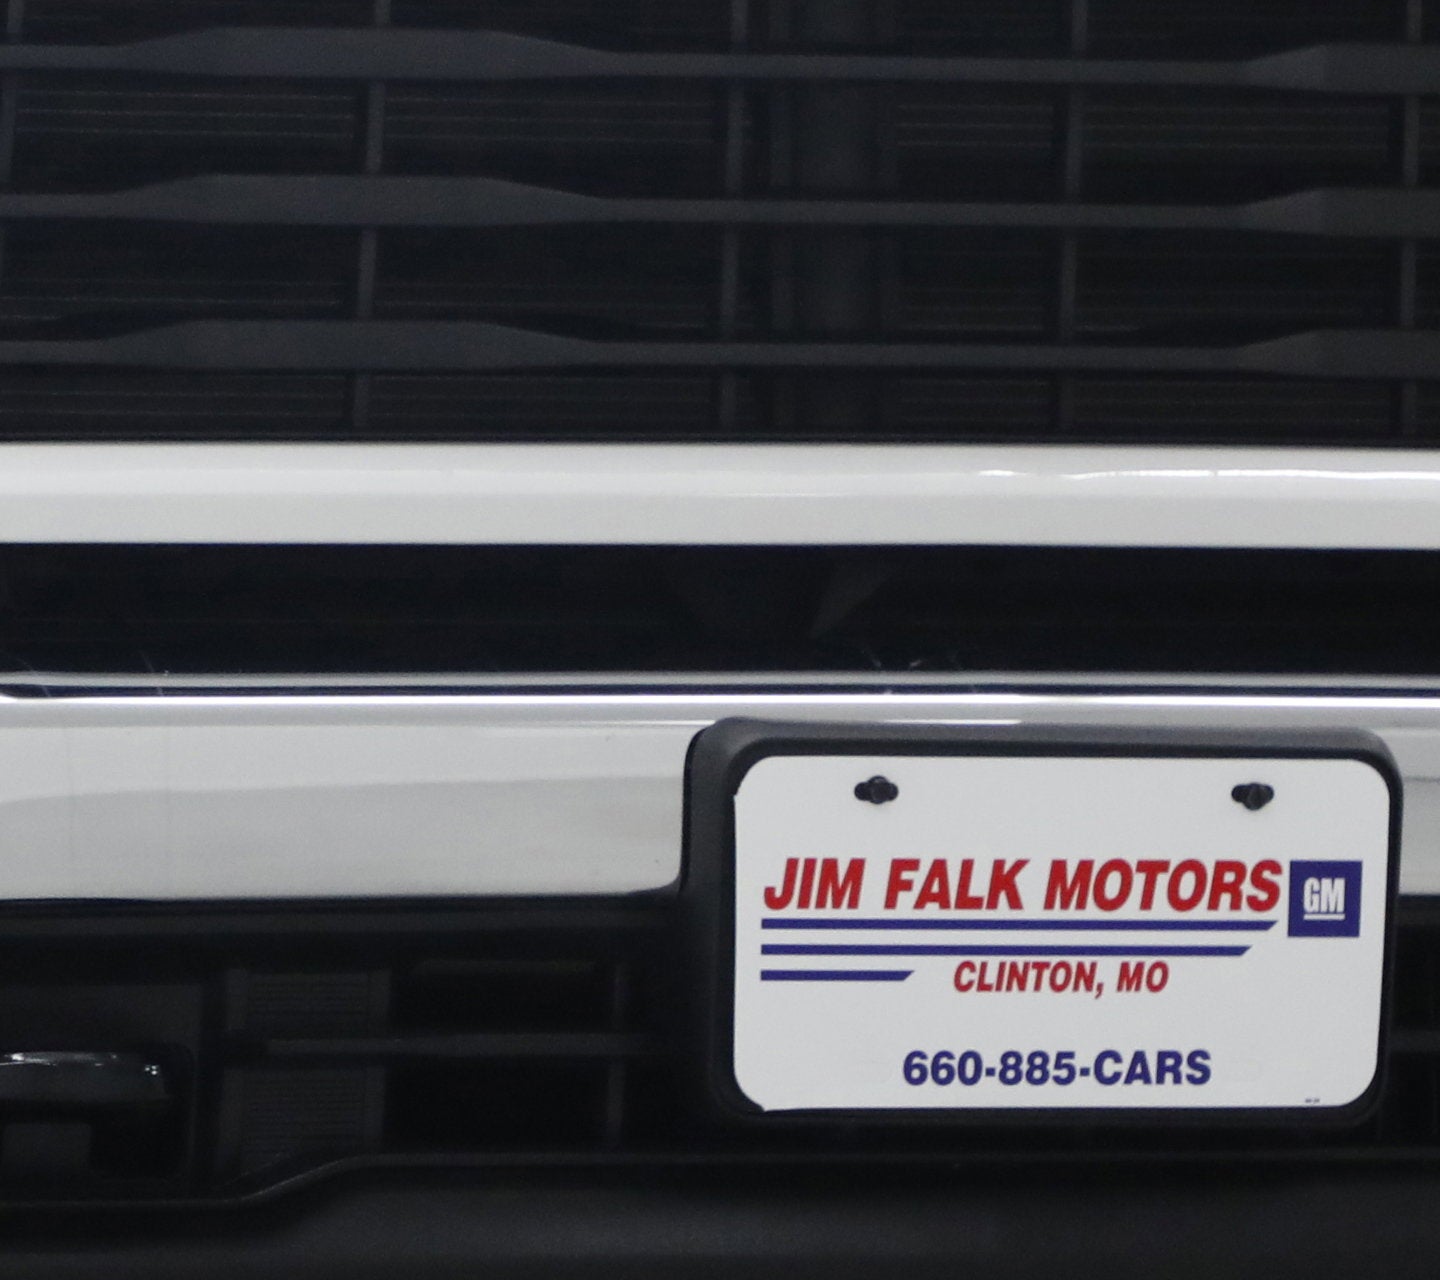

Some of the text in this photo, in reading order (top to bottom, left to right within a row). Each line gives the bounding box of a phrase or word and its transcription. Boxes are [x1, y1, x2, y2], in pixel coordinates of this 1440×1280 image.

[763, 857, 1284, 913] JIM FALK MOTORS
[1303, 877, 1346, 913] GM
[953, 960, 1170, 999] CLINTON, MO
[902, 1049, 1212, 1086] 660-885-CARS
